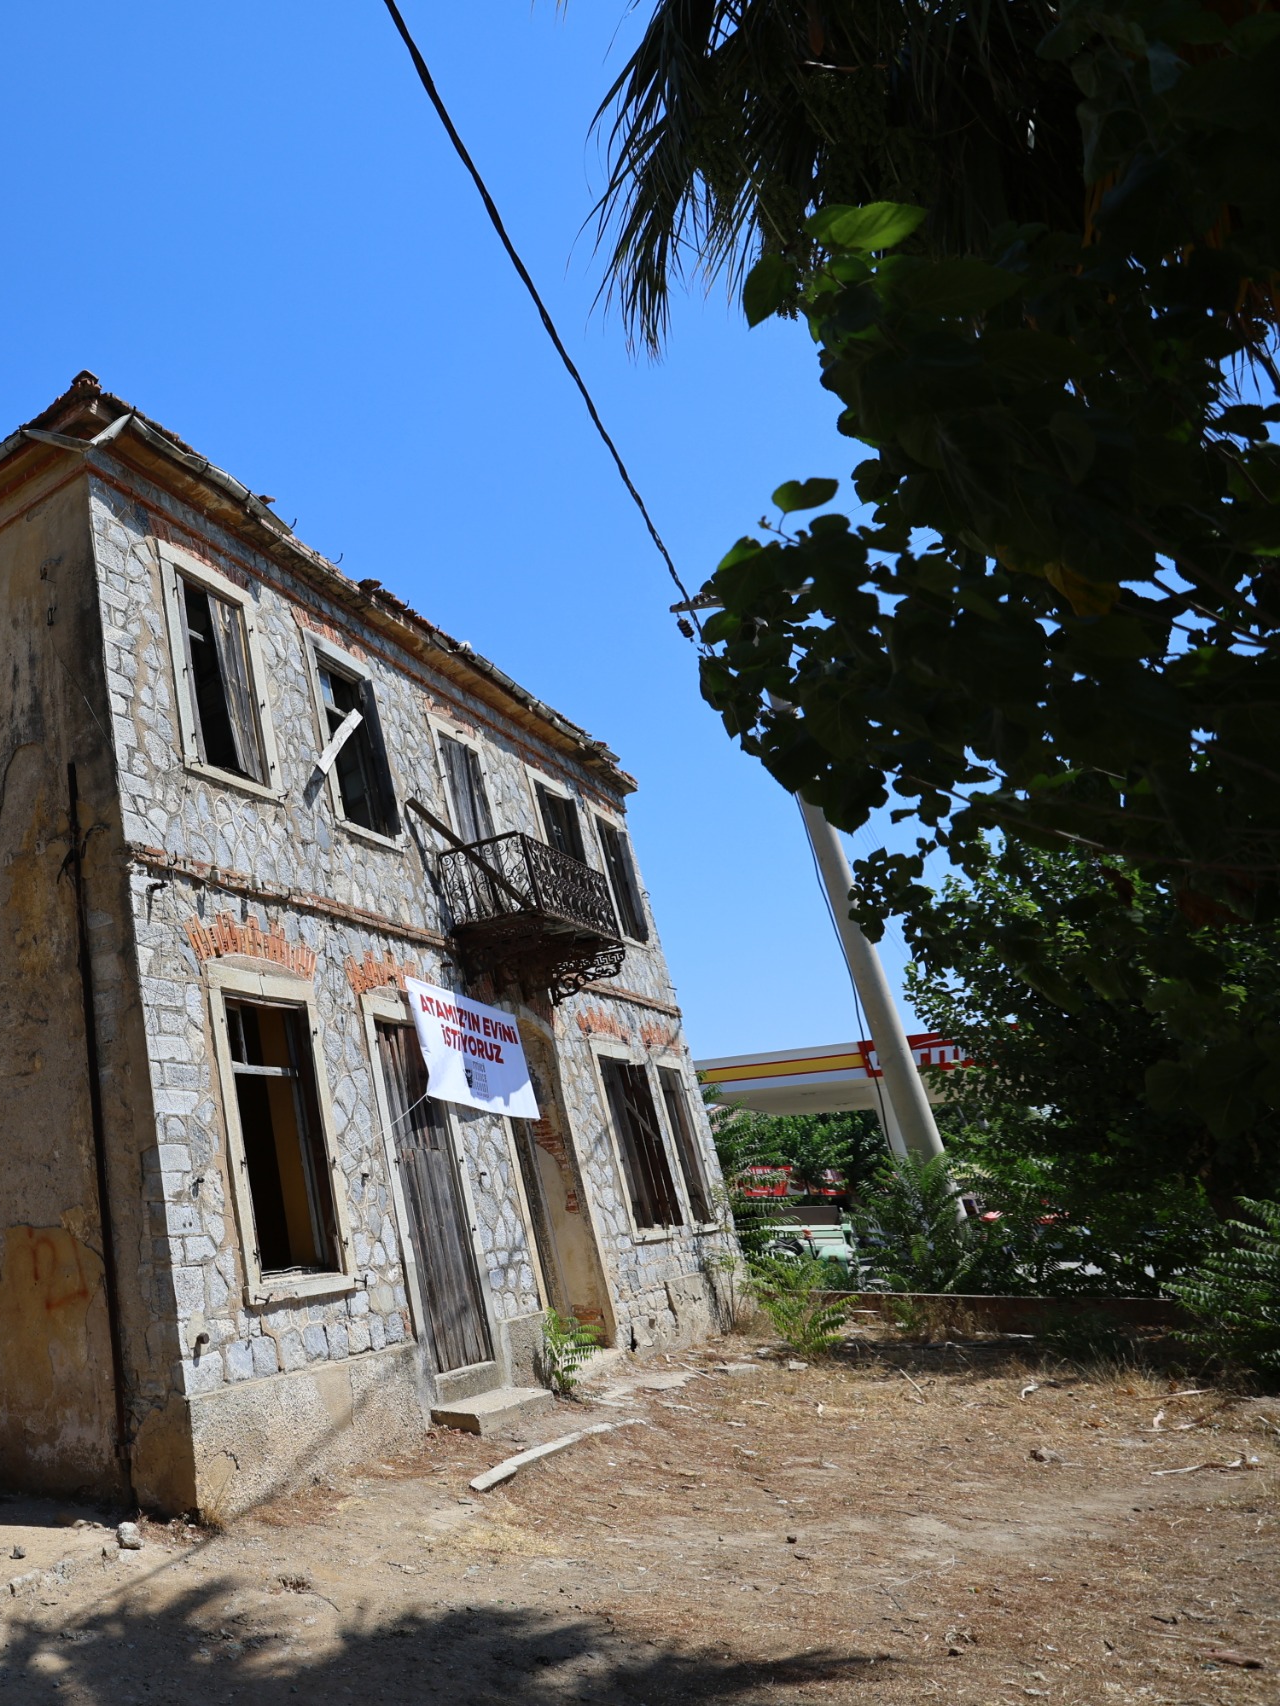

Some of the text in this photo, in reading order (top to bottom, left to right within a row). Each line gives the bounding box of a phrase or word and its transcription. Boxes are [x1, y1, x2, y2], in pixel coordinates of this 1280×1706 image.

[420, 995, 519, 1045] ATAMIZ'IN EVİNİ
[441, 1024, 504, 1064] İSTİYORUZ
